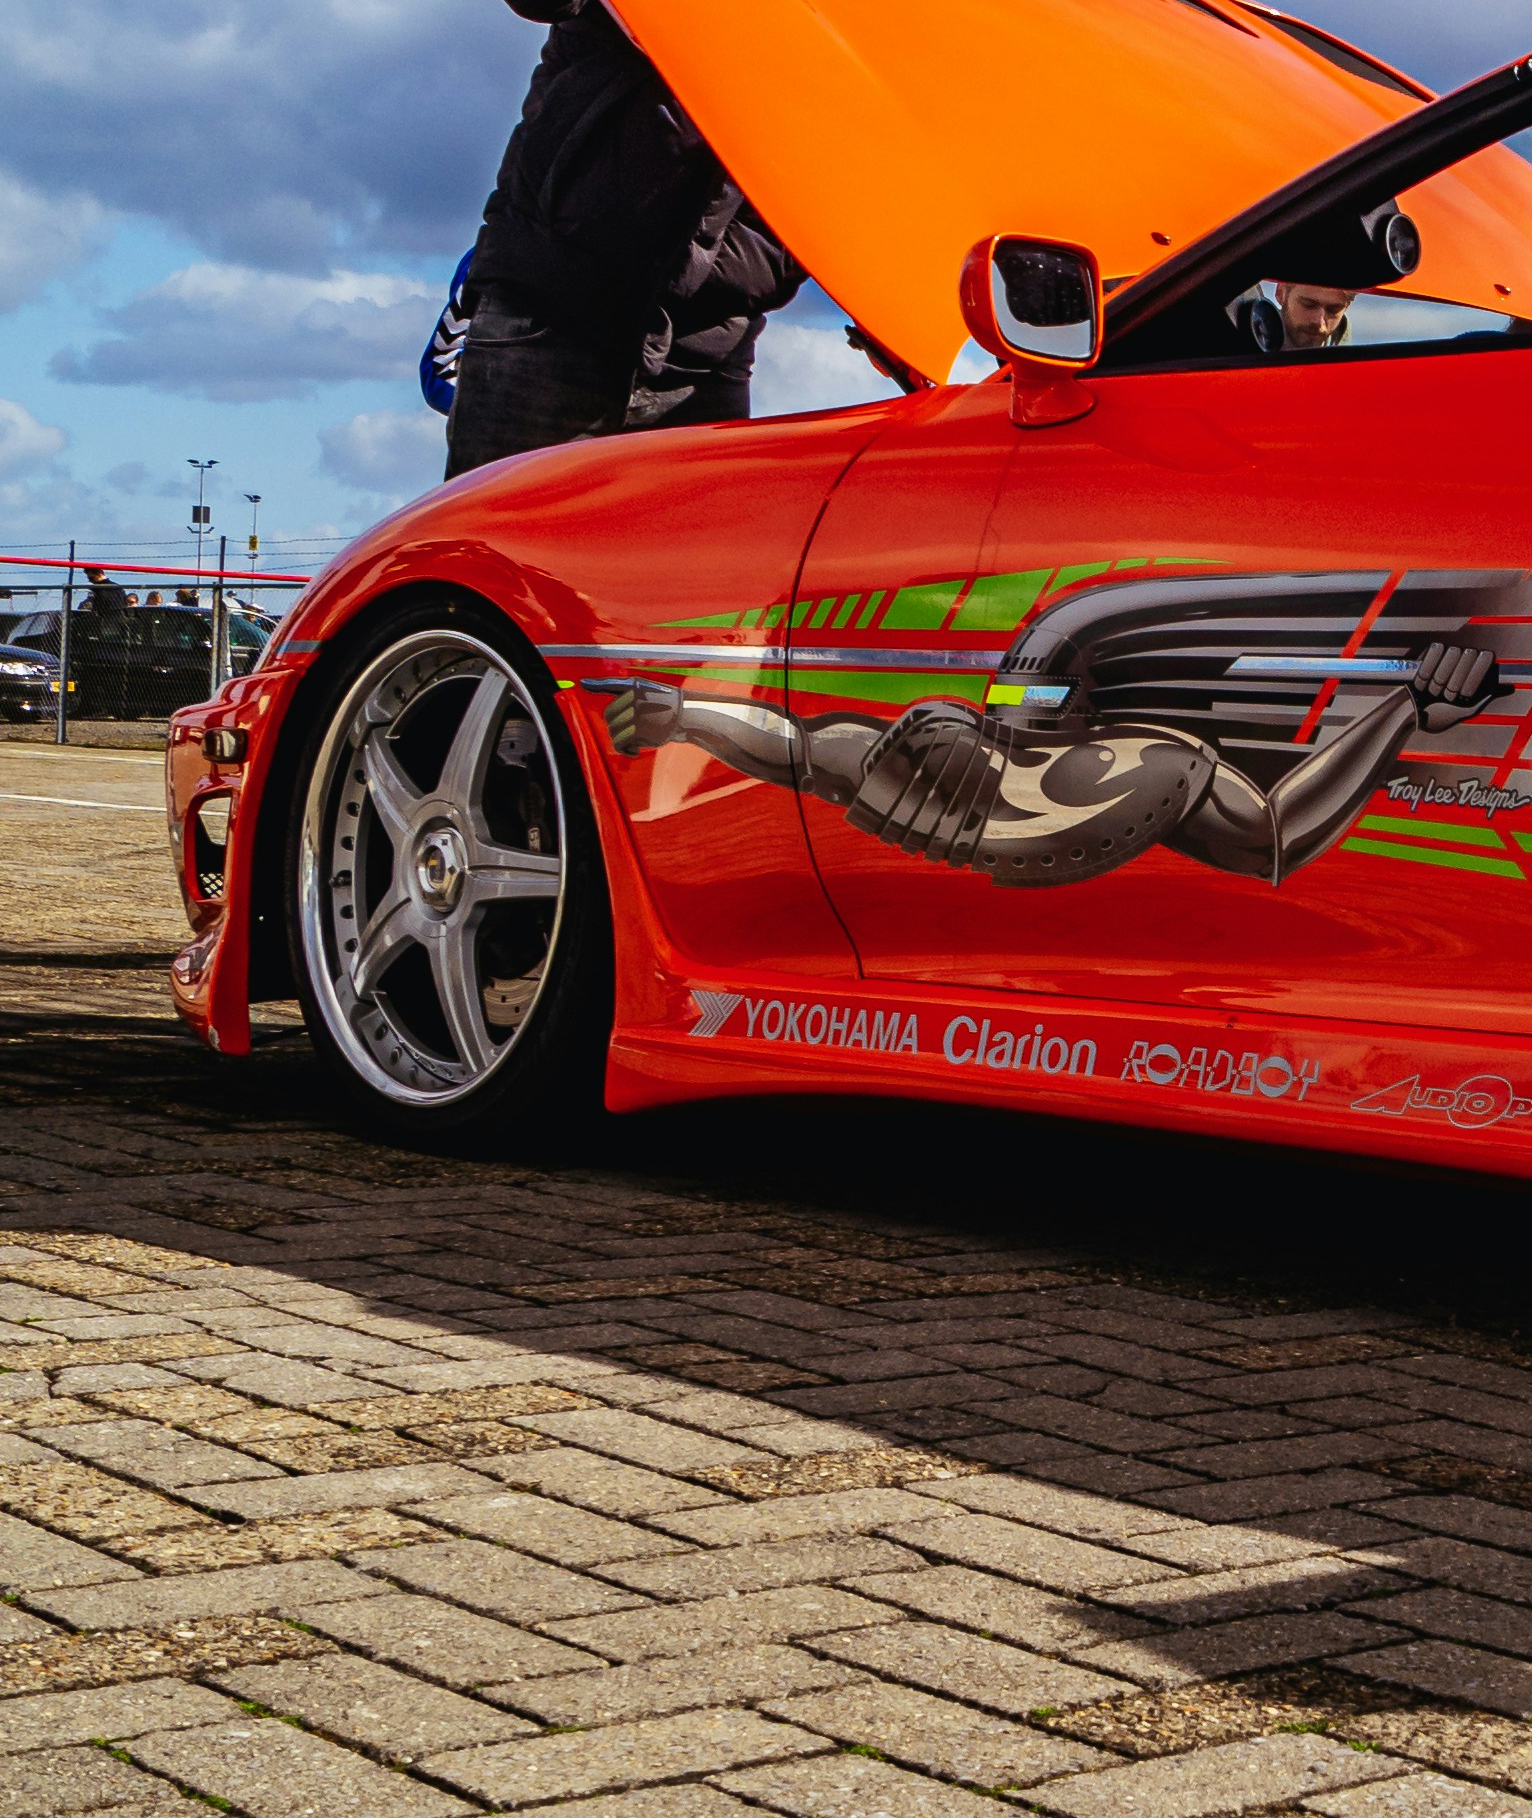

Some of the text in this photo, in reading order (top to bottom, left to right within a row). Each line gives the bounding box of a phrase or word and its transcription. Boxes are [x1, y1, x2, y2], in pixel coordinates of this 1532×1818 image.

[1387, 776, 1532, 818] Troy Lee Designs
[744, 998, 919, 1054] YOKOHAMA
[942, 1014, 1097, 1077] Clarion
[1121, 1040, 1320, 1101] ROADBOY
